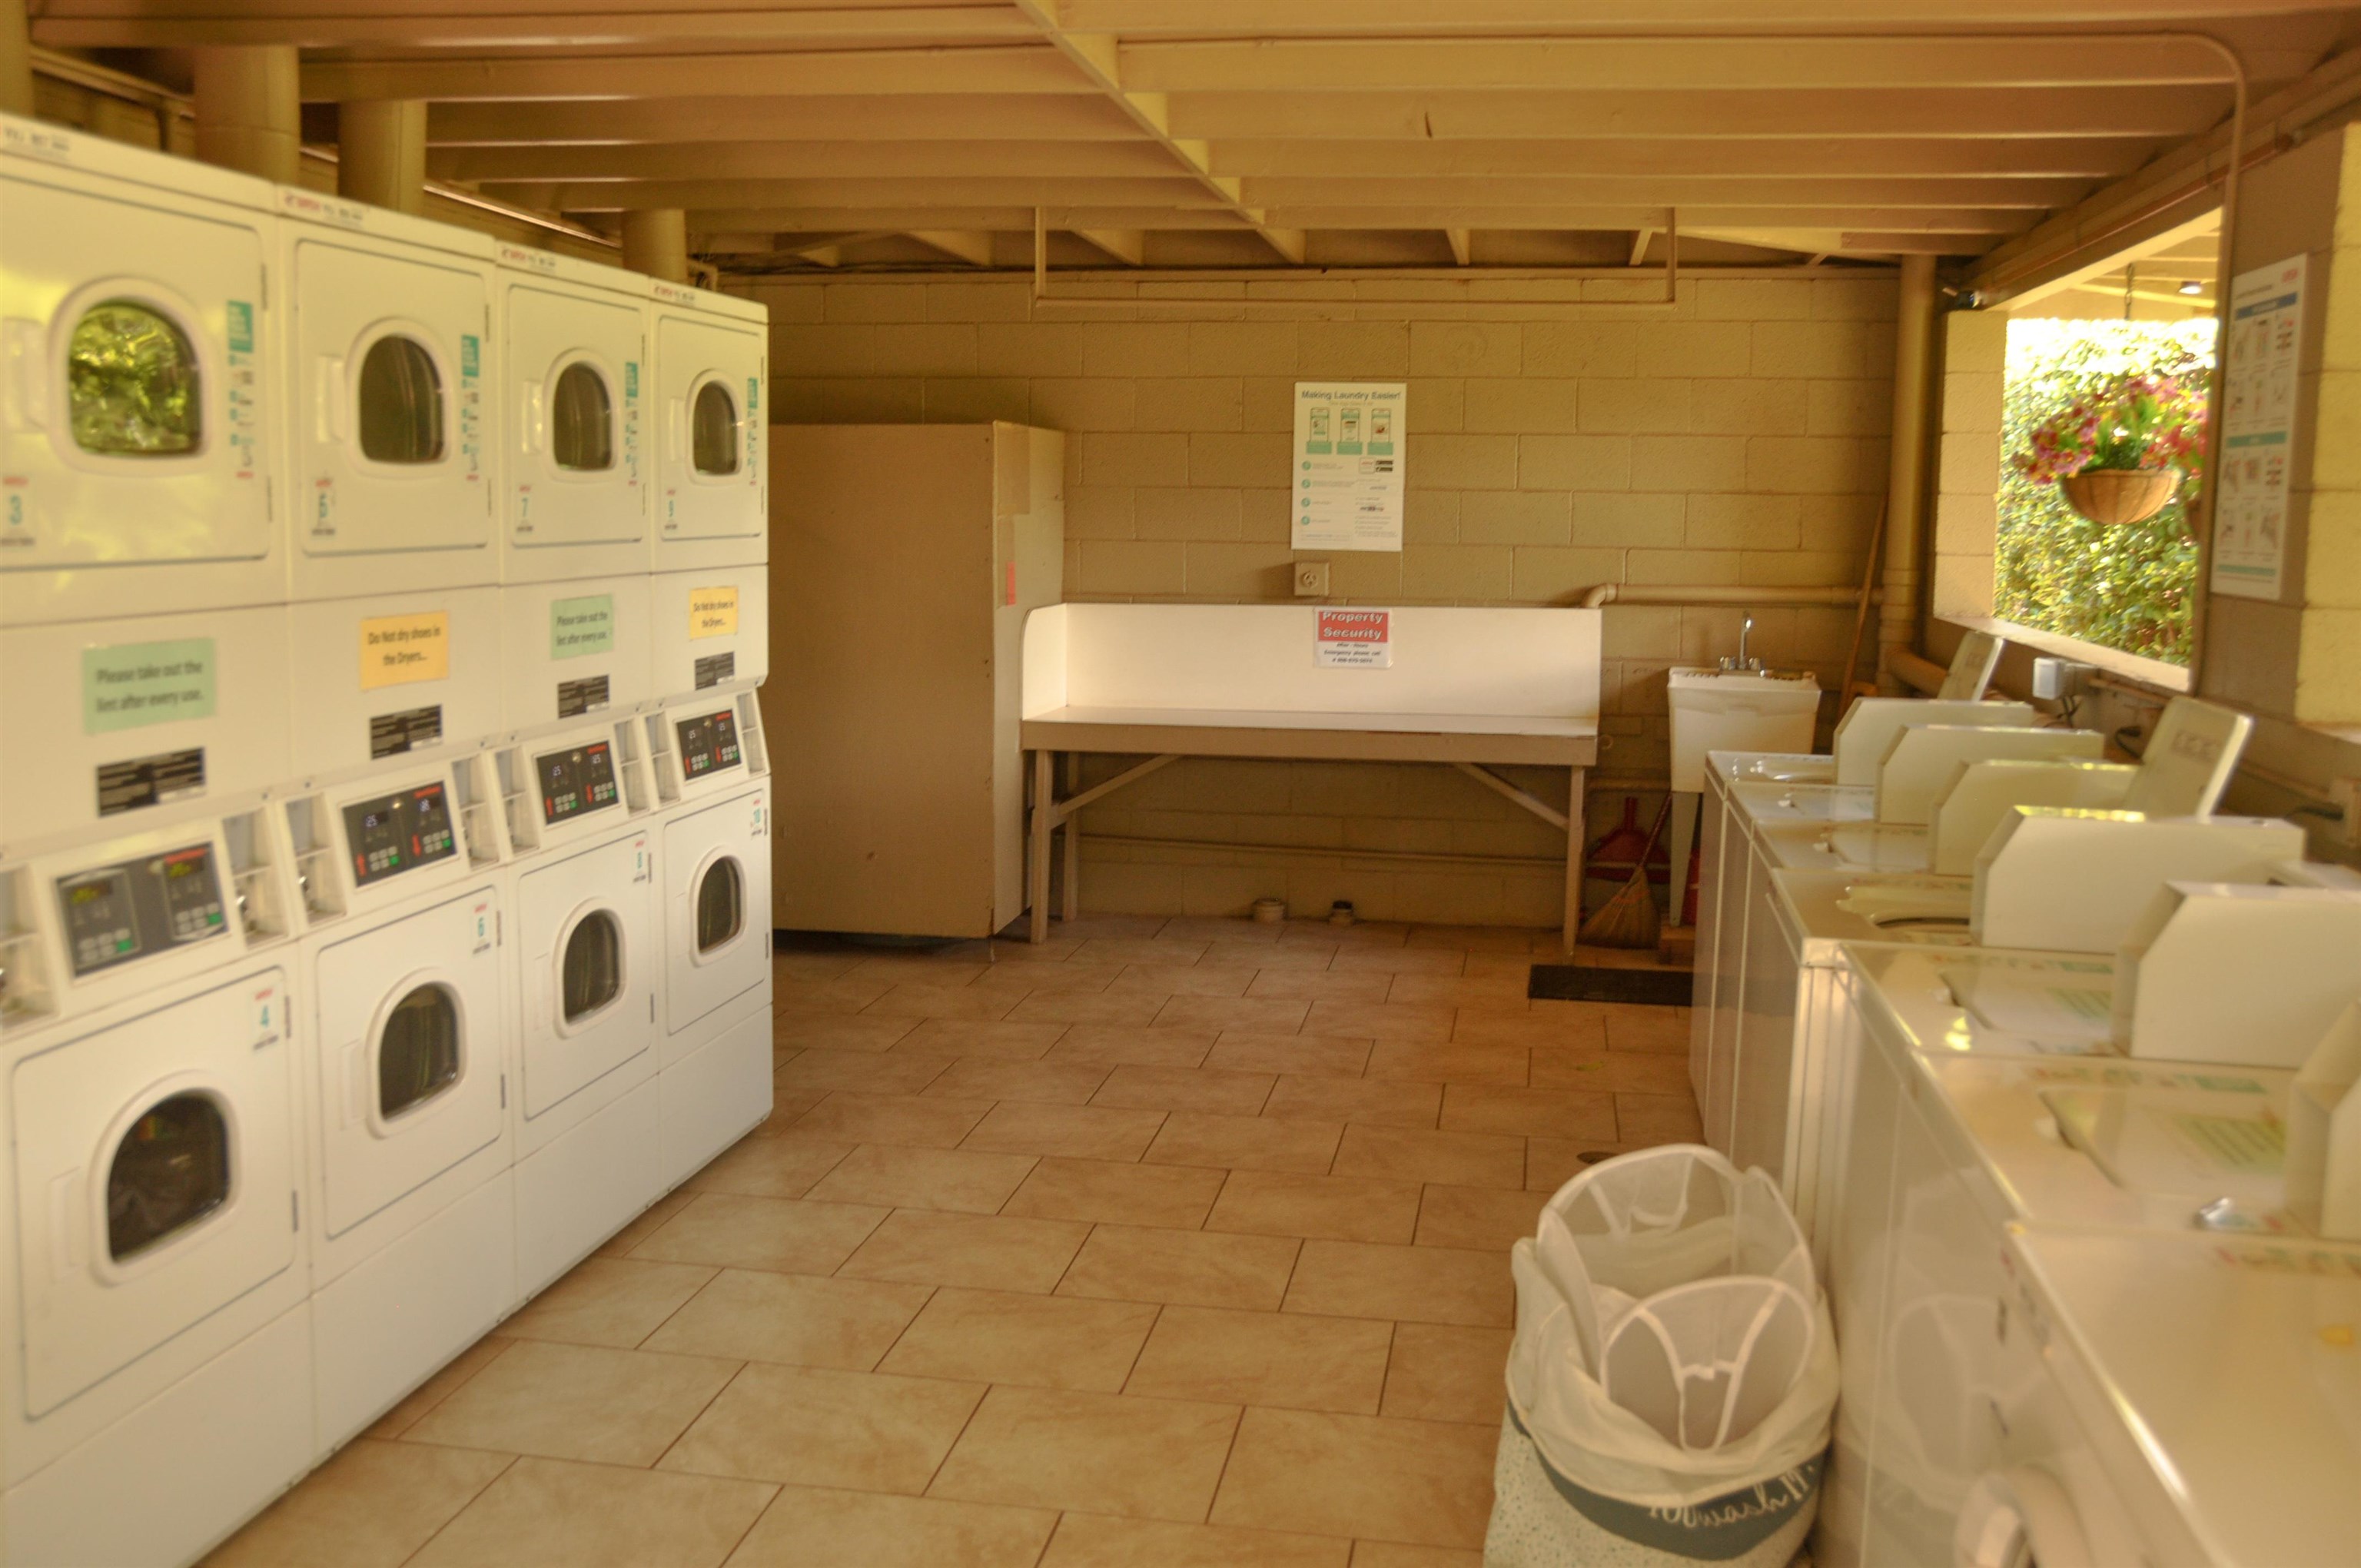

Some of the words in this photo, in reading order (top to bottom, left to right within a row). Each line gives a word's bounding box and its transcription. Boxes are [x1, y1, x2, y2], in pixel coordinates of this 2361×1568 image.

[1301, 390, 1332, 400] Making
[1334, 390, 1369, 401] Laundry
[1371, 390, 1401, 400] Easier!
[556, 615, 575, 627] Please
[1322, 611, 1383, 624] Property
[367, 631, 380, 645] Do
[1323, 626, 1382, 640] Security
[96, 668, 134, 685] Please
[137, 663, 161, 681] take
[163, 663, 182, 677] out
[184, 660, 202, 675] the
[121, 693, 147, 710] after
[148, 692, 178, 708] every
